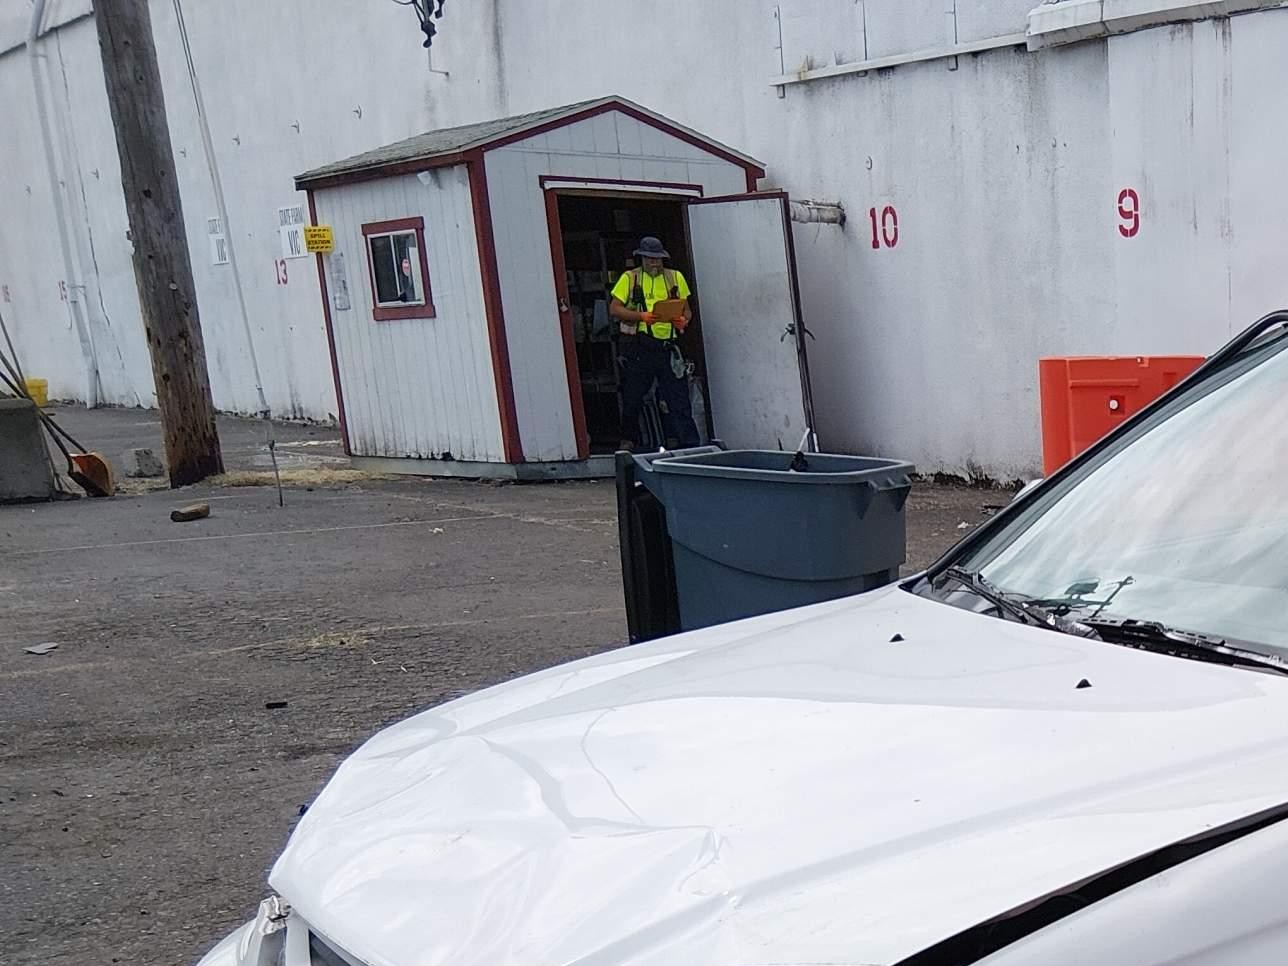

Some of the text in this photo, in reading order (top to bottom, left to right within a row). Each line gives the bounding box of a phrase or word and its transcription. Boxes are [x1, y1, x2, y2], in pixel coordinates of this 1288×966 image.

[870, 206, 898, 249] 10
[1118, 188, 1139, 238] 9
[288, 230, 300, 255] VIC
[275, 259, 288, 285] 13
